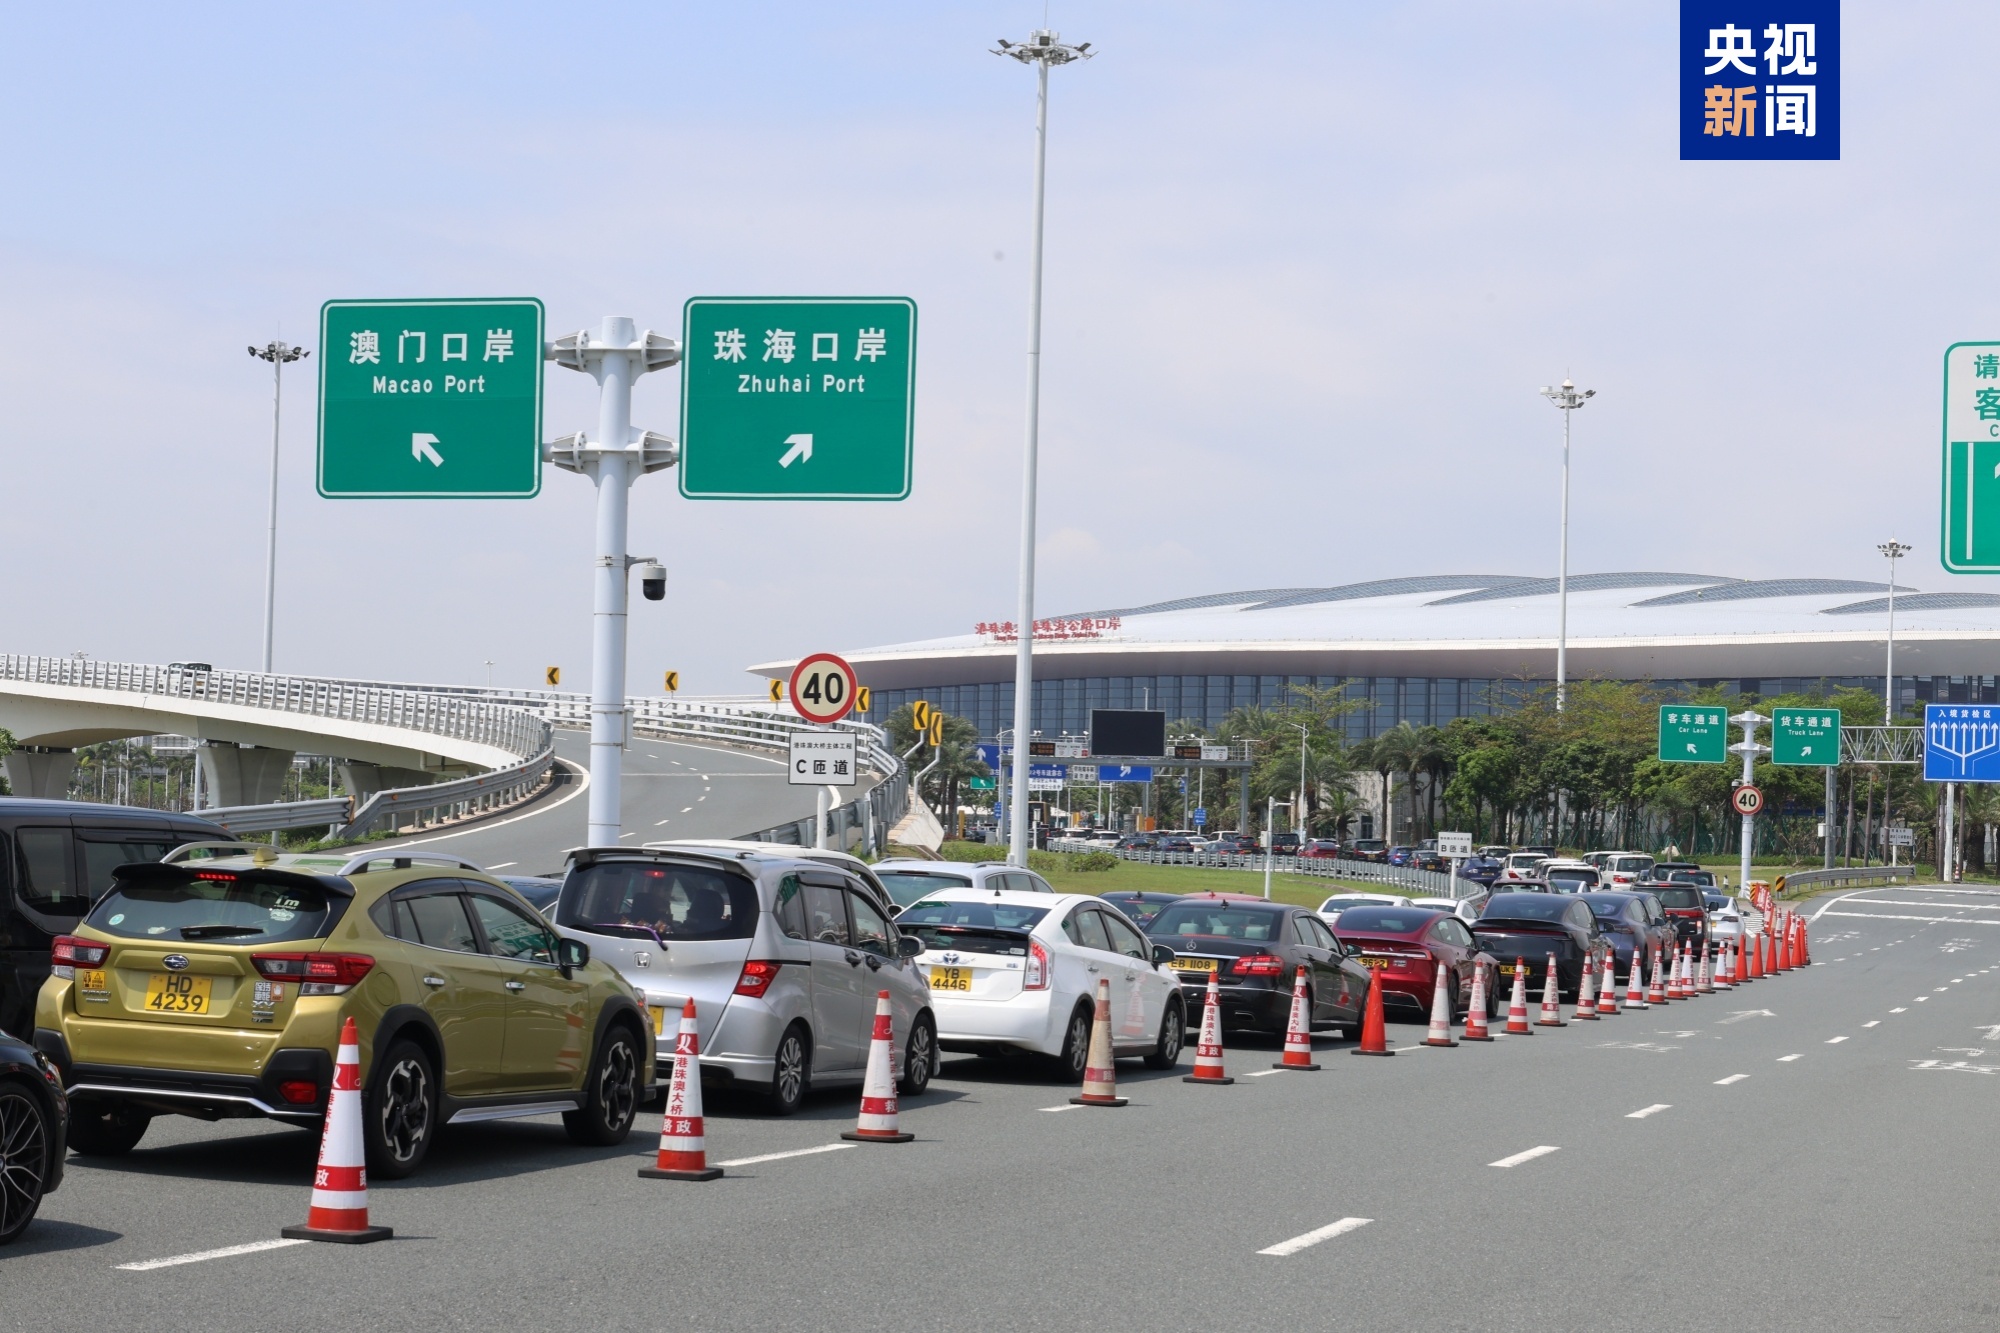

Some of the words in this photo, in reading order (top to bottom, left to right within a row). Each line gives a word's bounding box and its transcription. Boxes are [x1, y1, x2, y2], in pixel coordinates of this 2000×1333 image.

[349, 329, 515, 364] 澳门口岸
[713, 328, 887, 363] 珠海口岸
[373, 376, 433, 394] Macao
[444, 375, 486, 393] Port
[738, 375, 811, 393] Zhuhai
[822, 375, 866, 393] Port
[975, 617, 1121, 635] 港珠澳珠海公路口岸
[803, 673, 844, 704] 40
[1667, 713, 1720, 725] 客车通道
[1780, 716, 1832, 728] 货车通道
[1938, 709, 1991, 719] 入境货检区
[1738, 793, 1757, 807] 40
[944, 968, 960, 979] YB
[1171, 960, 1185, 968] EB
[1189, 960, 1211, 969] 1108
[166, 975, 193, 994] HD
[933, 979, 967, 990] 4446
[150, 992, 203, 1012] 4239
[1290, 998, 1300, 1032] 港珠澳大桥
[1204, 1007, 1215, 1044] 港珠澳大桥
[1198, 1046, 1219, 1056] 路政
[670, 1057, 688, 1115] 港珠澳大桥
[662, 1119, 691, 1134] 路政
